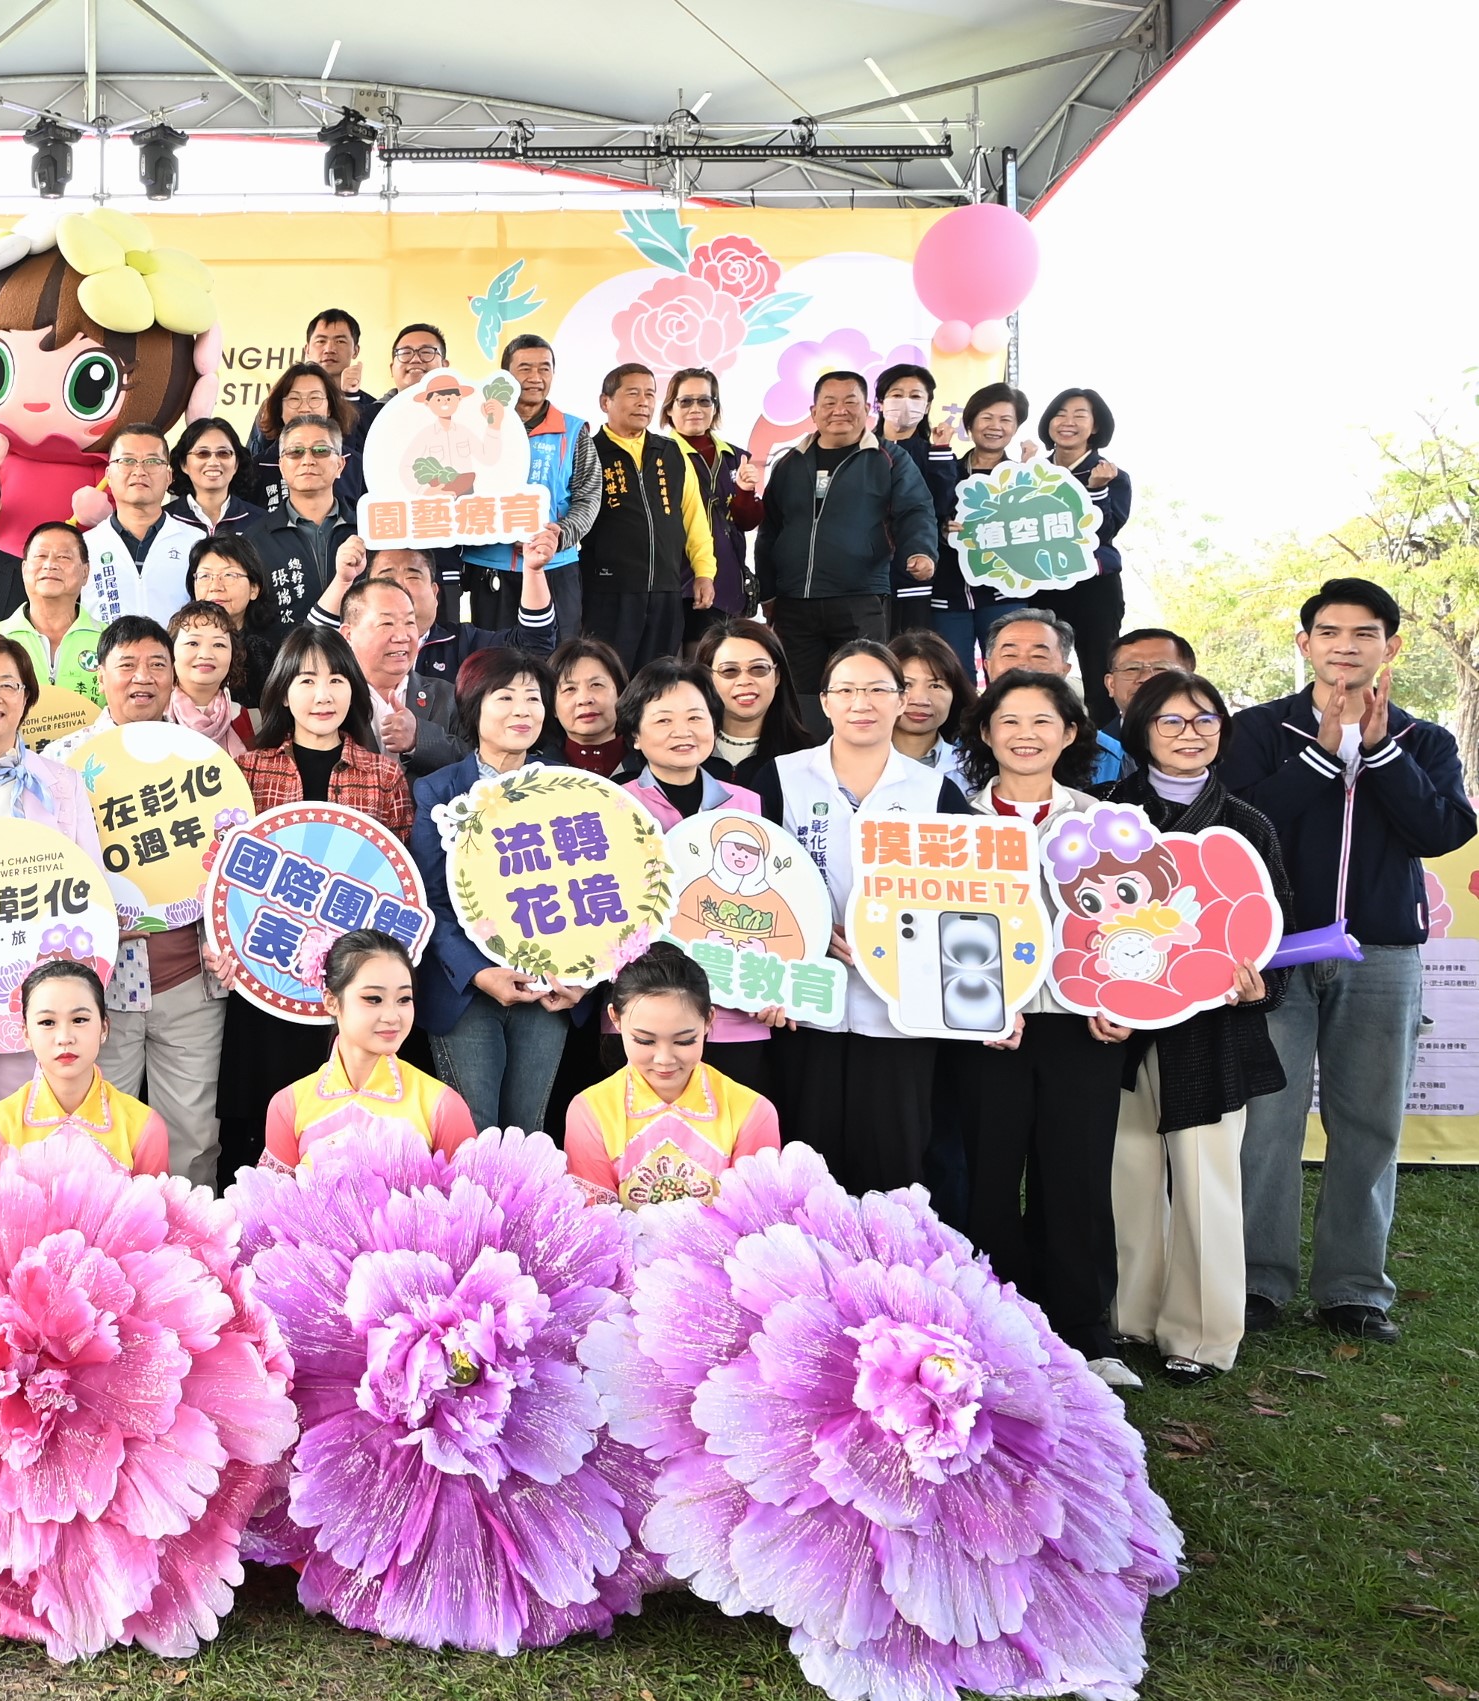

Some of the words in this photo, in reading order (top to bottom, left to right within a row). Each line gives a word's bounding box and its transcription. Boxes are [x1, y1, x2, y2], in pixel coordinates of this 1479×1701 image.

[221, 347, 306, 370] NGHU
[215, 383, 272, 406] STI
[367, 494, 541, 540] 園藝療育
[976, 511, 1075, 549] 植空間
[287, 557, 305, 599] 總幹事
[22, 718, 40, 727] 20TH
[41, 710, 87, 723] CHANGHUA
[22, 725, 52, 736] FLOWER
[53, 719, 87, 730] FESTIVAL
[92, 765, 223, 833] 在彰化
[8, 851, 65, 866] CHANGHUA
[102, 816, 206, 873] 0週年
[491, 812, 610, 877] 流轉
[861, 820, 1028, 872] 摸彩抽
[22, 863, 64, 875] FESTIVAL
[225, 836, 423, 951] 國際團體
[505, 873, 629, 939] 花境
[248, 911, 304, 968] 表
[660, 933, 836, 1014] 農教育
